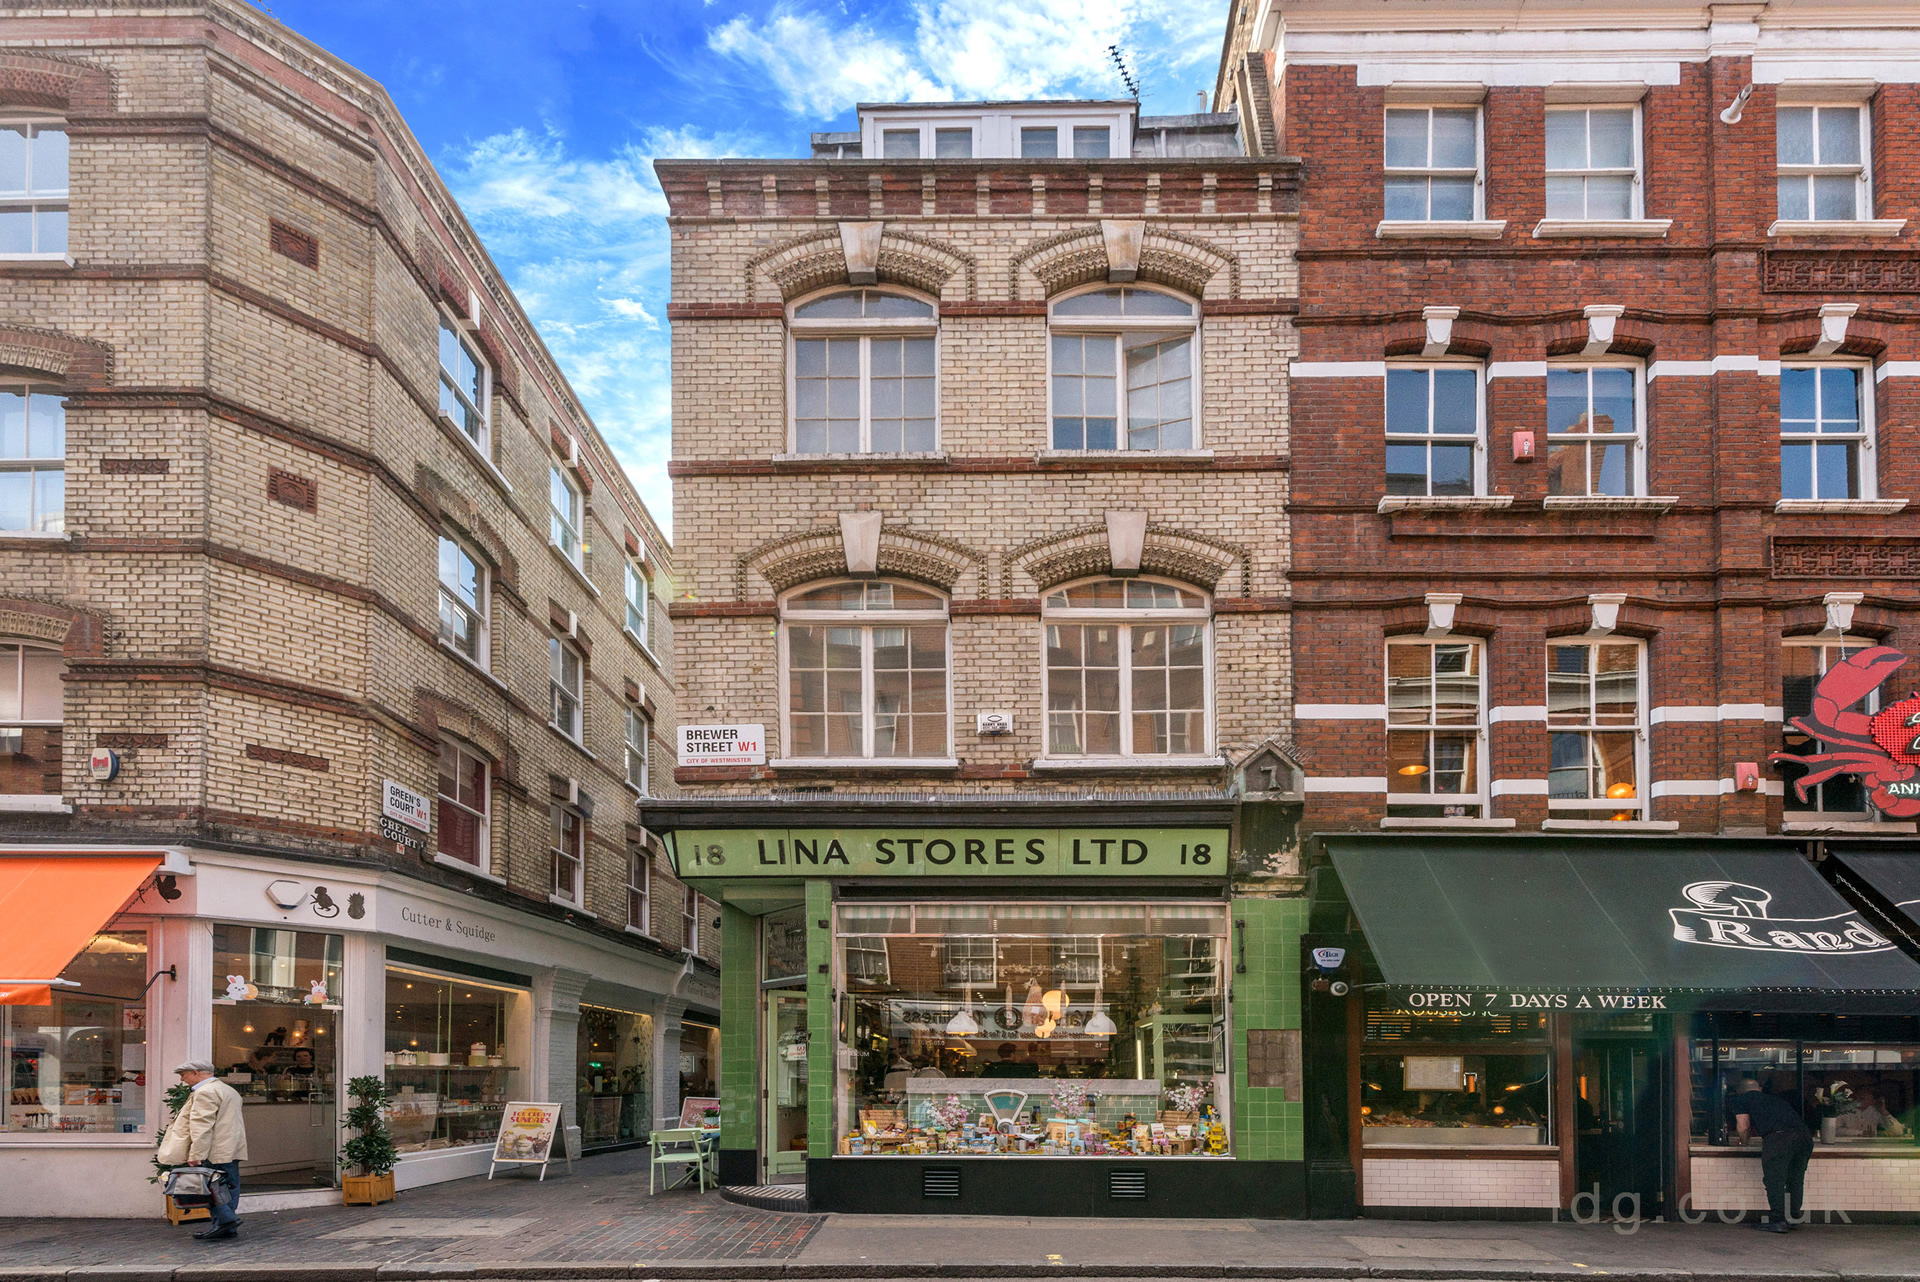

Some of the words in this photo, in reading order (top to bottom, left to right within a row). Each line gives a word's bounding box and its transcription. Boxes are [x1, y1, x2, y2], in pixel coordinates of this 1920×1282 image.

[686, 729, 738, 740] BREWER
[686, 741, 733, 753] STREET
[738, 741, 757, 752] W1
[390, 785, 421, 807] GREEN'S
[390, 797, 415, 815] COURT
[416, 808, 427, 821] W1
[384, 828, 418, 848] COURT
[694, 844, 726, 866] 18
[757, 838, 850, 865] LINA
[875, 838, 1045, 865] STORES
[1072, 838, 1149, 865] LTD
[1180, 843, 1212, 865] 18
[401, 906, 442, 929] Cutter
[445, 917, 453, 932] &
[456, 920, 496, 942] Squidge
[1700, 917, 1892, 951] Rand
[1408, 992, 1472, 1009] OPEN
[1484, 993, 1498, 1008] 7
[1509, 993, 1568, 1009] DAYS
[1574, 994, 1593, 1009] A
[1598, 994, 1667, 1010] WEEK
[510, 1116, 551, 1124] SUNDAES
